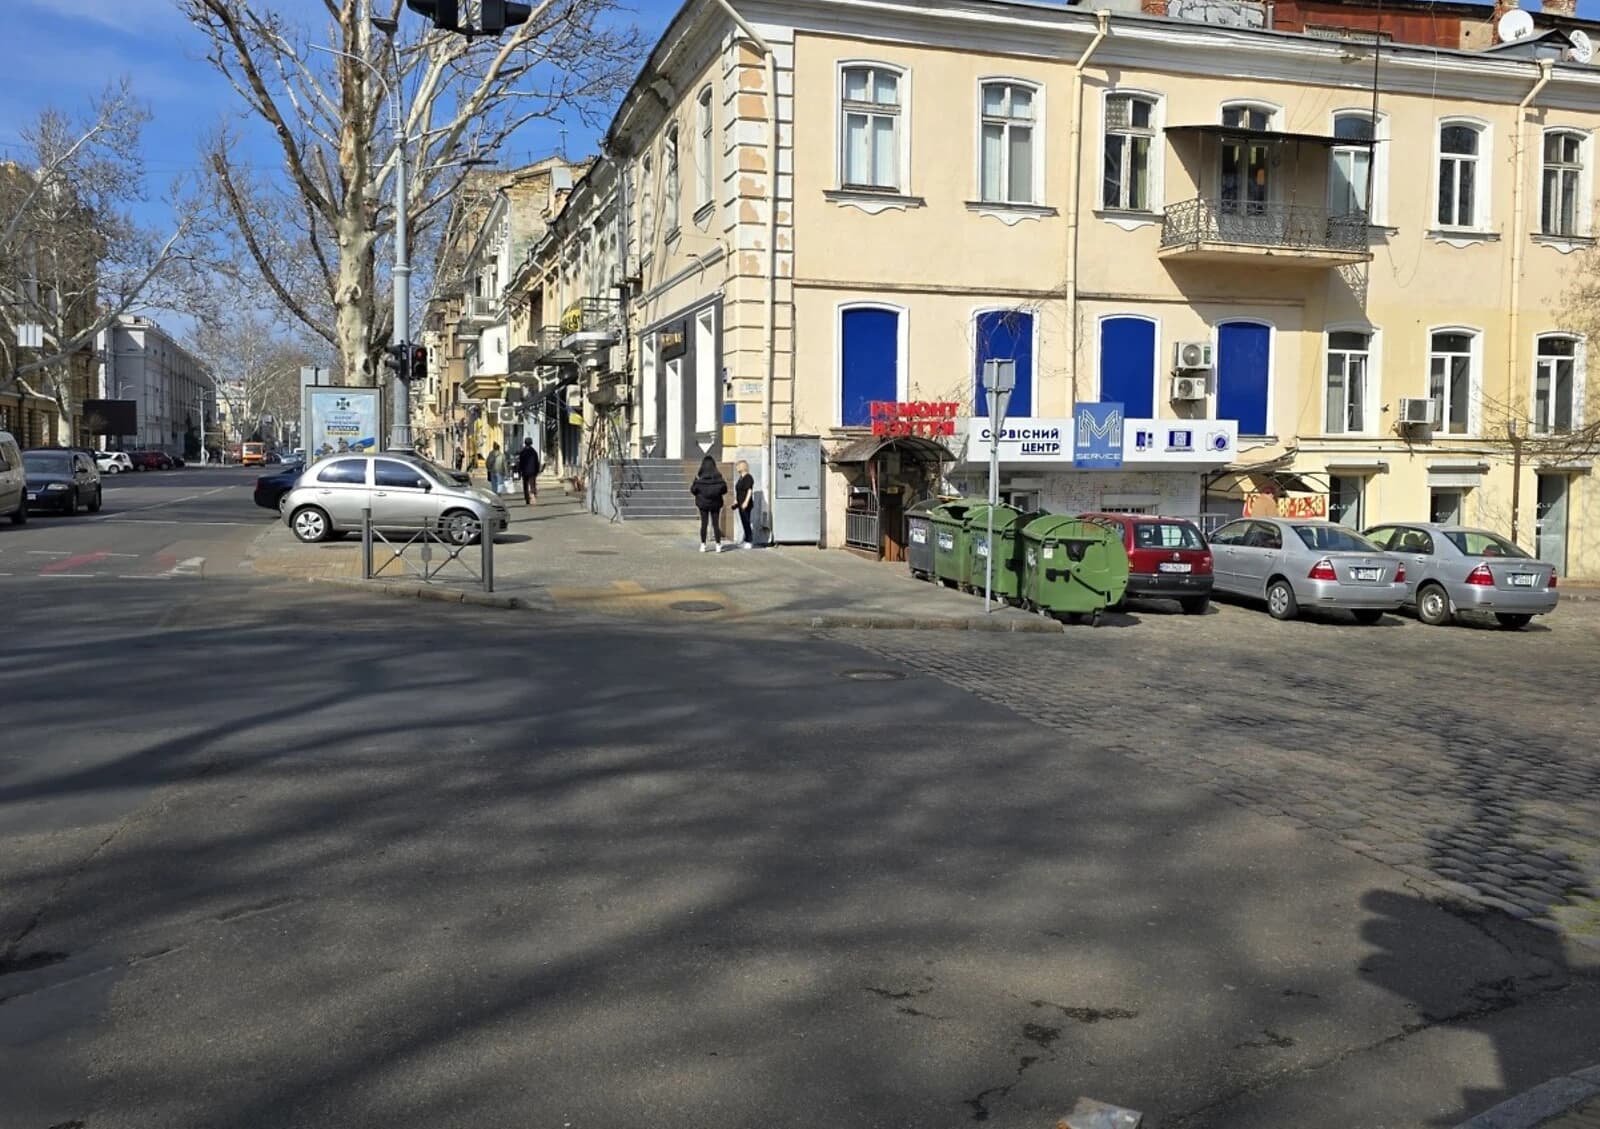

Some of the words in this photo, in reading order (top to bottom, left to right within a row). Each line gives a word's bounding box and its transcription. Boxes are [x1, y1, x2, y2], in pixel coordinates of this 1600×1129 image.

[871, 401, 959, 417] РЕМОНТ
[981, 428, 1059, 439] СРВІСНИЙ
[1022, 443, 1060, 453] ЦЕНТР
